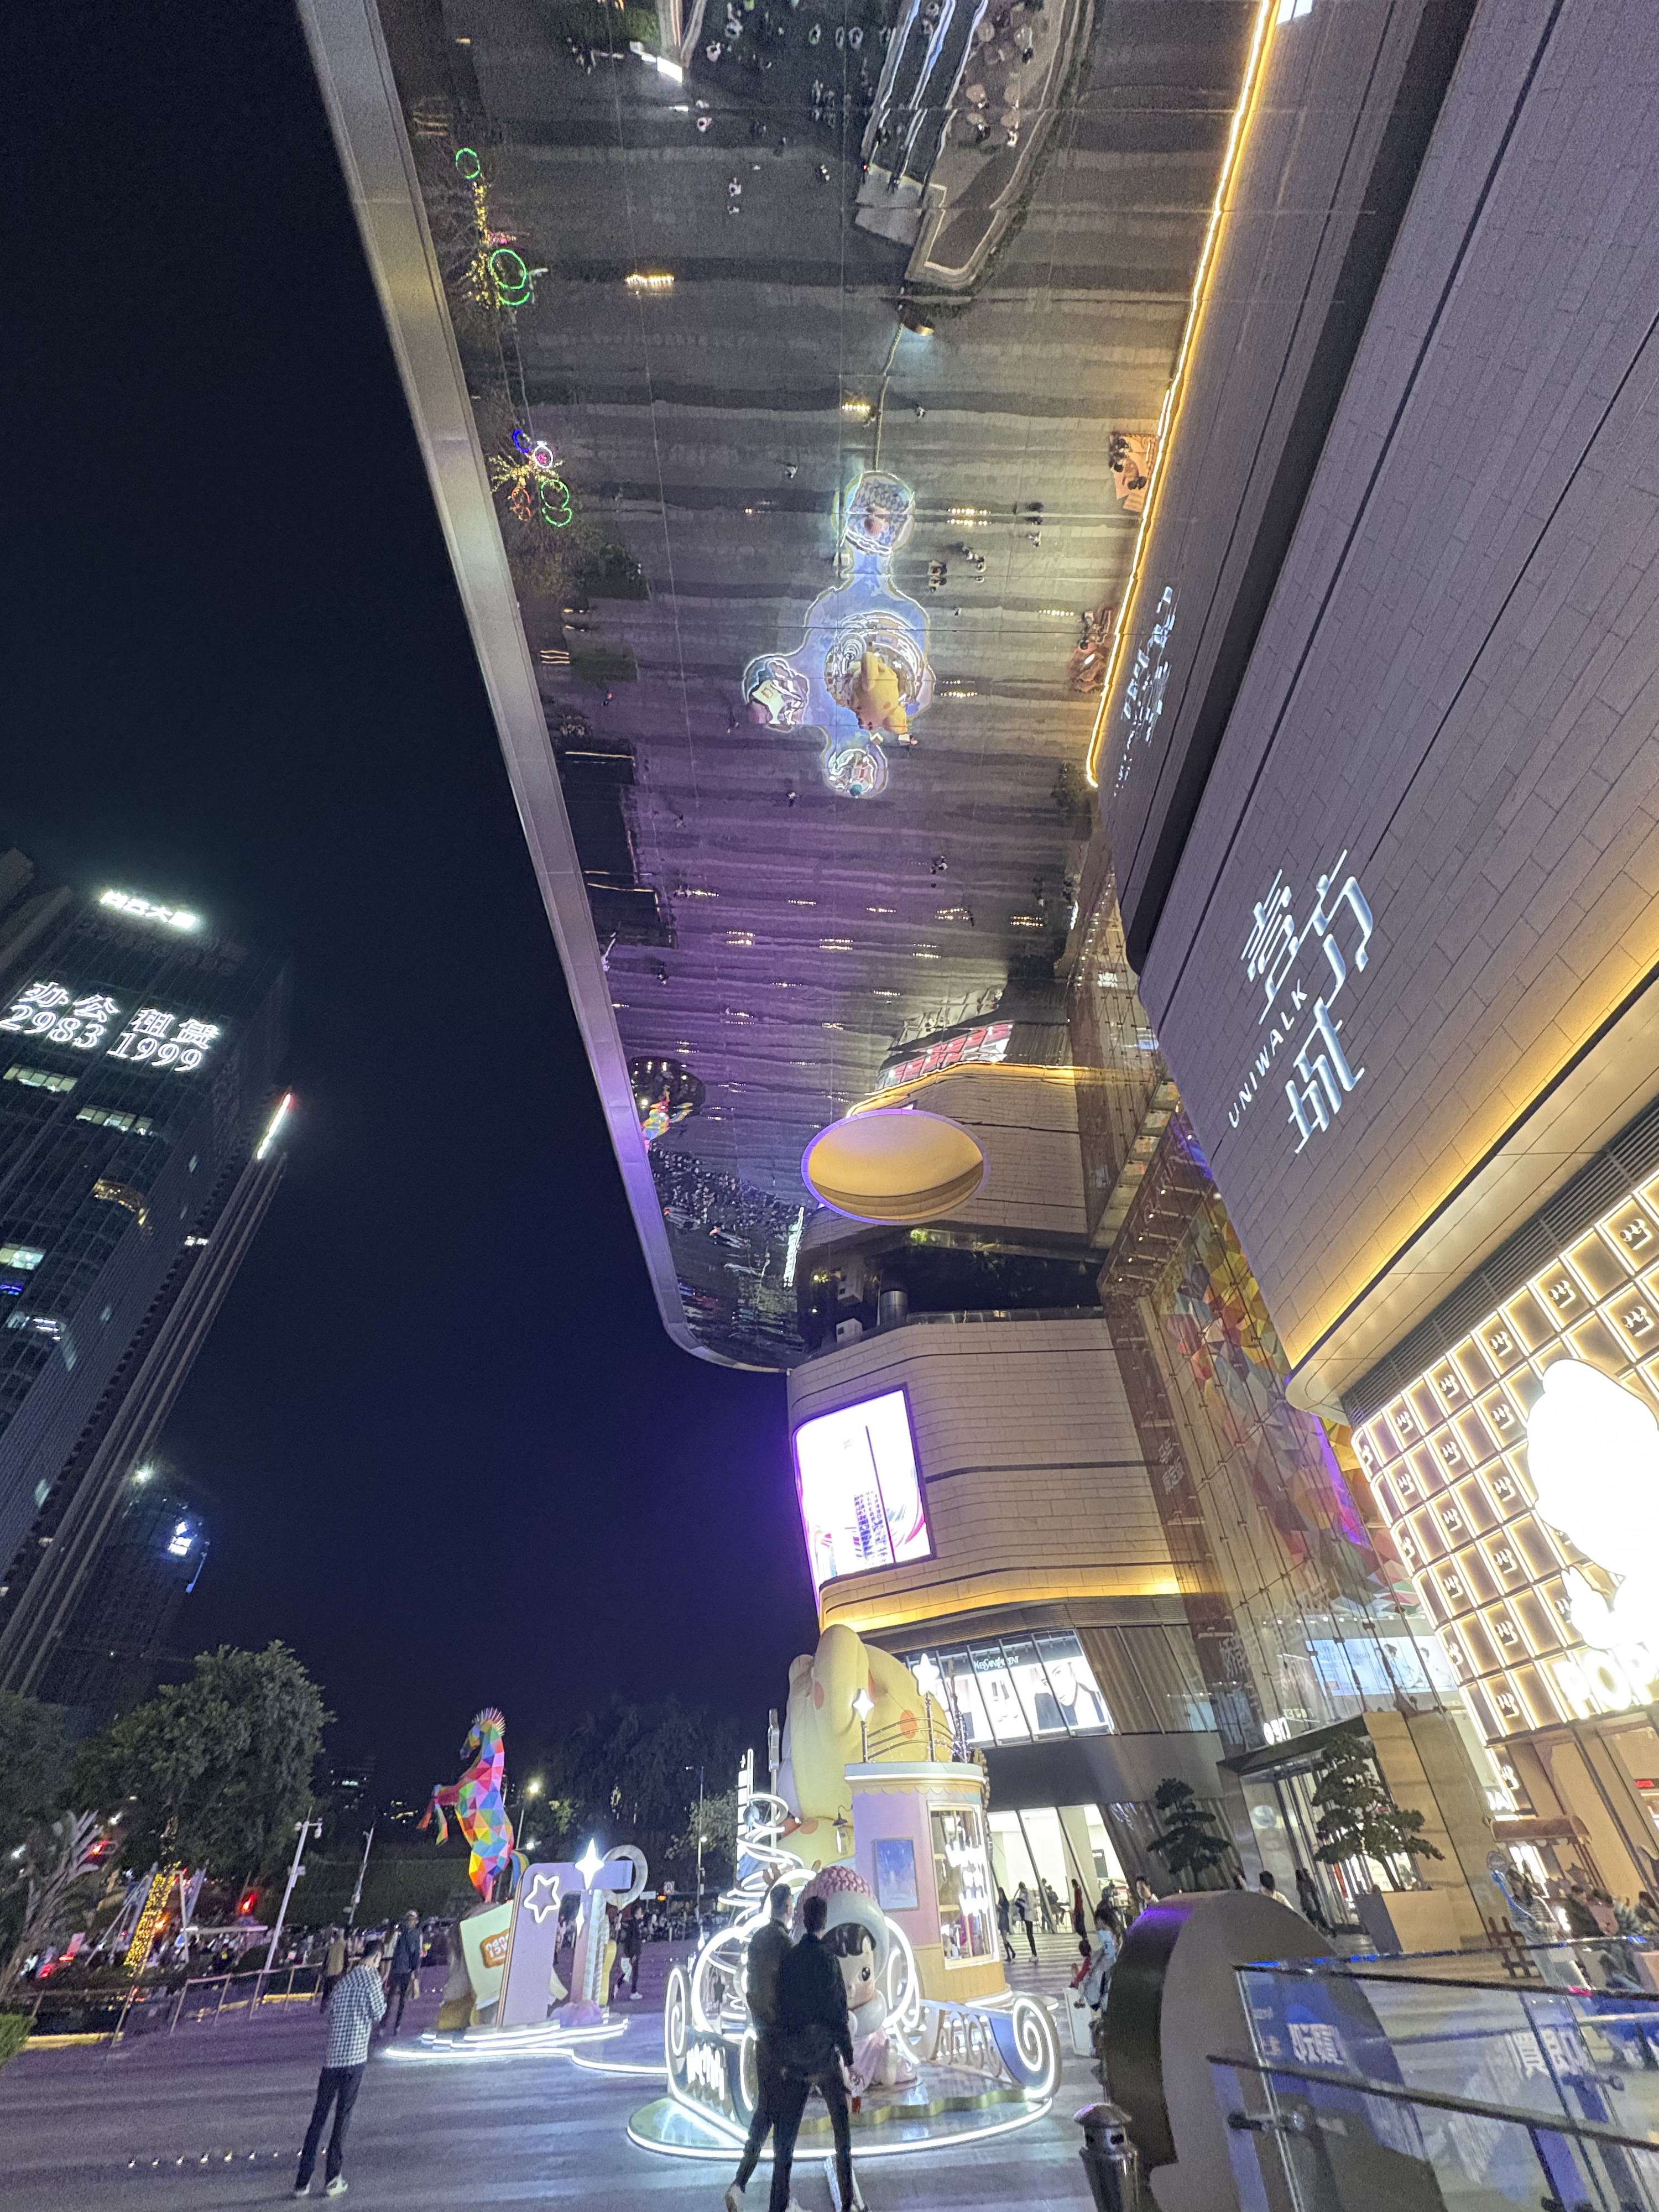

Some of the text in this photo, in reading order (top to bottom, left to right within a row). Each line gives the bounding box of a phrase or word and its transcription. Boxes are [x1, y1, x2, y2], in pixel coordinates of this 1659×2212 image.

[0, 1004, 204, 1072] 2983 1999
[1228, 978, 1308, 1129] UNIWALK
[1240, 849, 1374, 1154] 壹方城
[1552, 1641, 1657, 1720] POP
